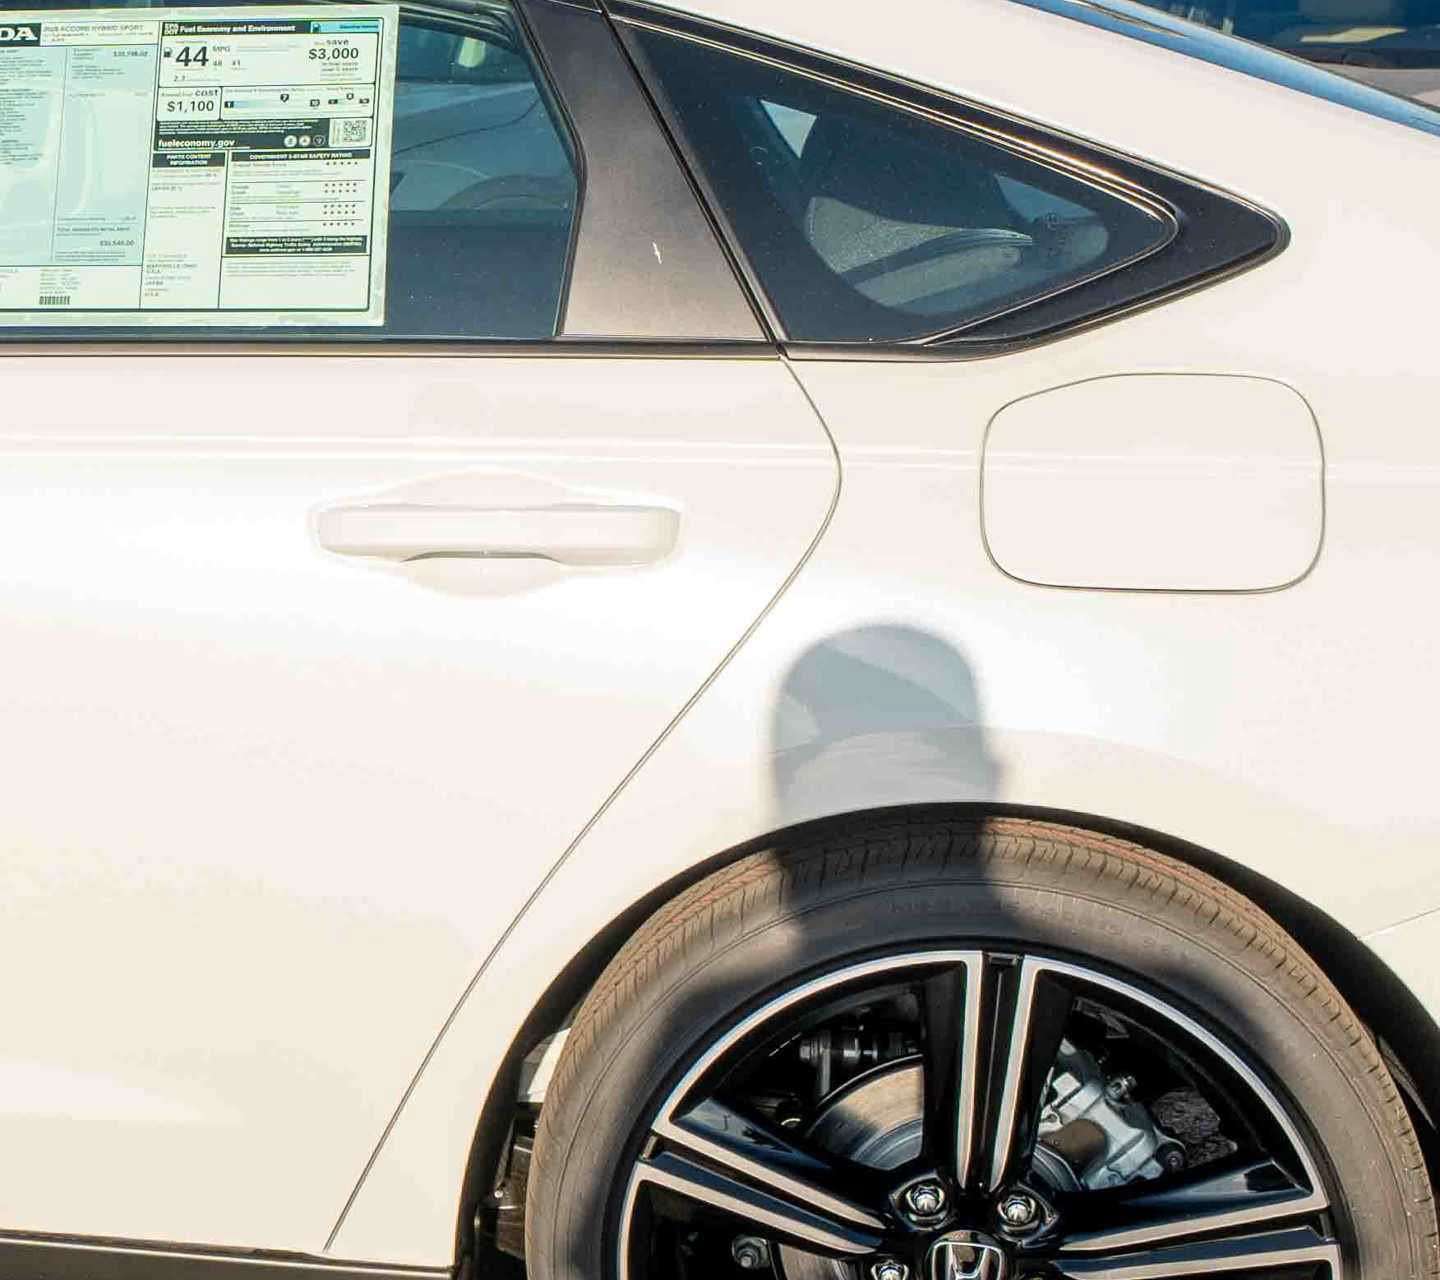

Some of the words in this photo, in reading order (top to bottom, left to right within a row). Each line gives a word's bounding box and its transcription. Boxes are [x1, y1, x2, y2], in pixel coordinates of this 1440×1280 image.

[175, 46, 209, 67] 44
[308, 47, 359, 61] $3,000
[167, 100, 214, 113] $1,100
[158, 139, 236, 148] fueleconomy.gov
